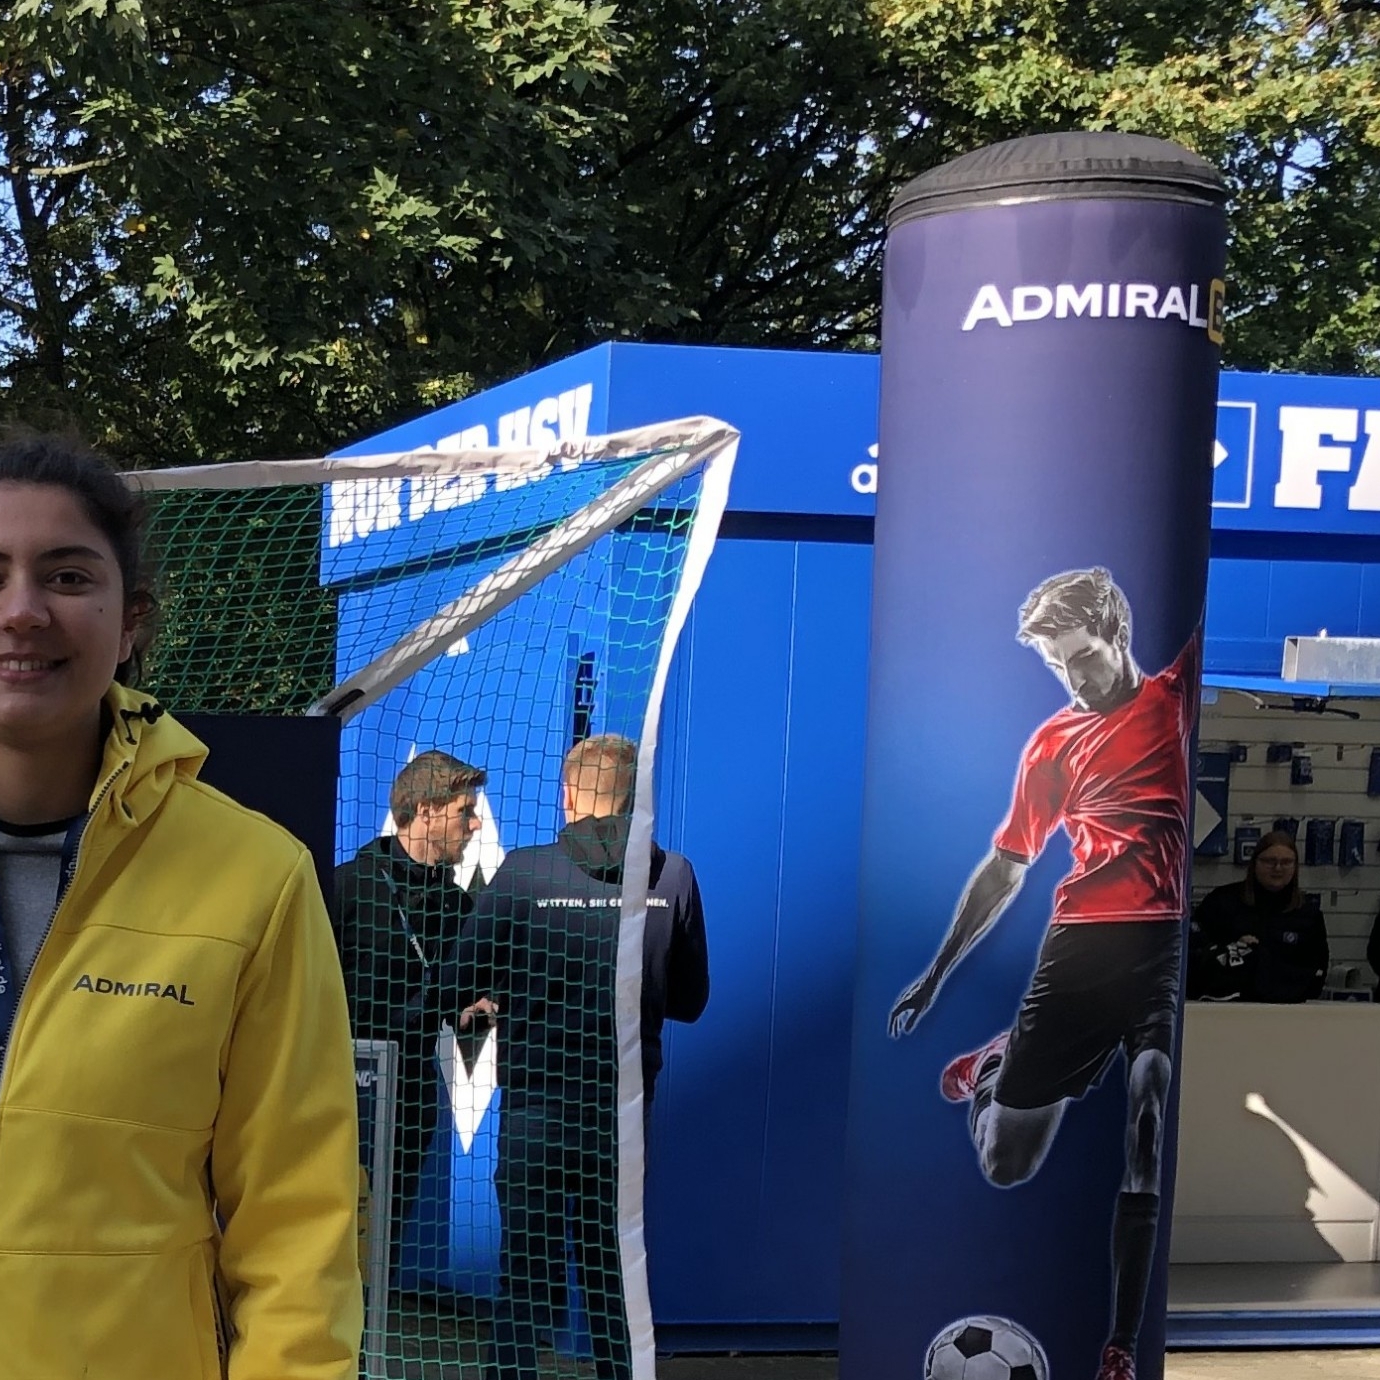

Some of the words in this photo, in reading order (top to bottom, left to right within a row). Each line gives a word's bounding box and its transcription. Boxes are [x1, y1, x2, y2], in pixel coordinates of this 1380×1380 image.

[961, 283, 1208, 331] ADMIRAL
[495, 383, 593, 492] HSV
[72, 974, 195, 1006] ADMIRAL
